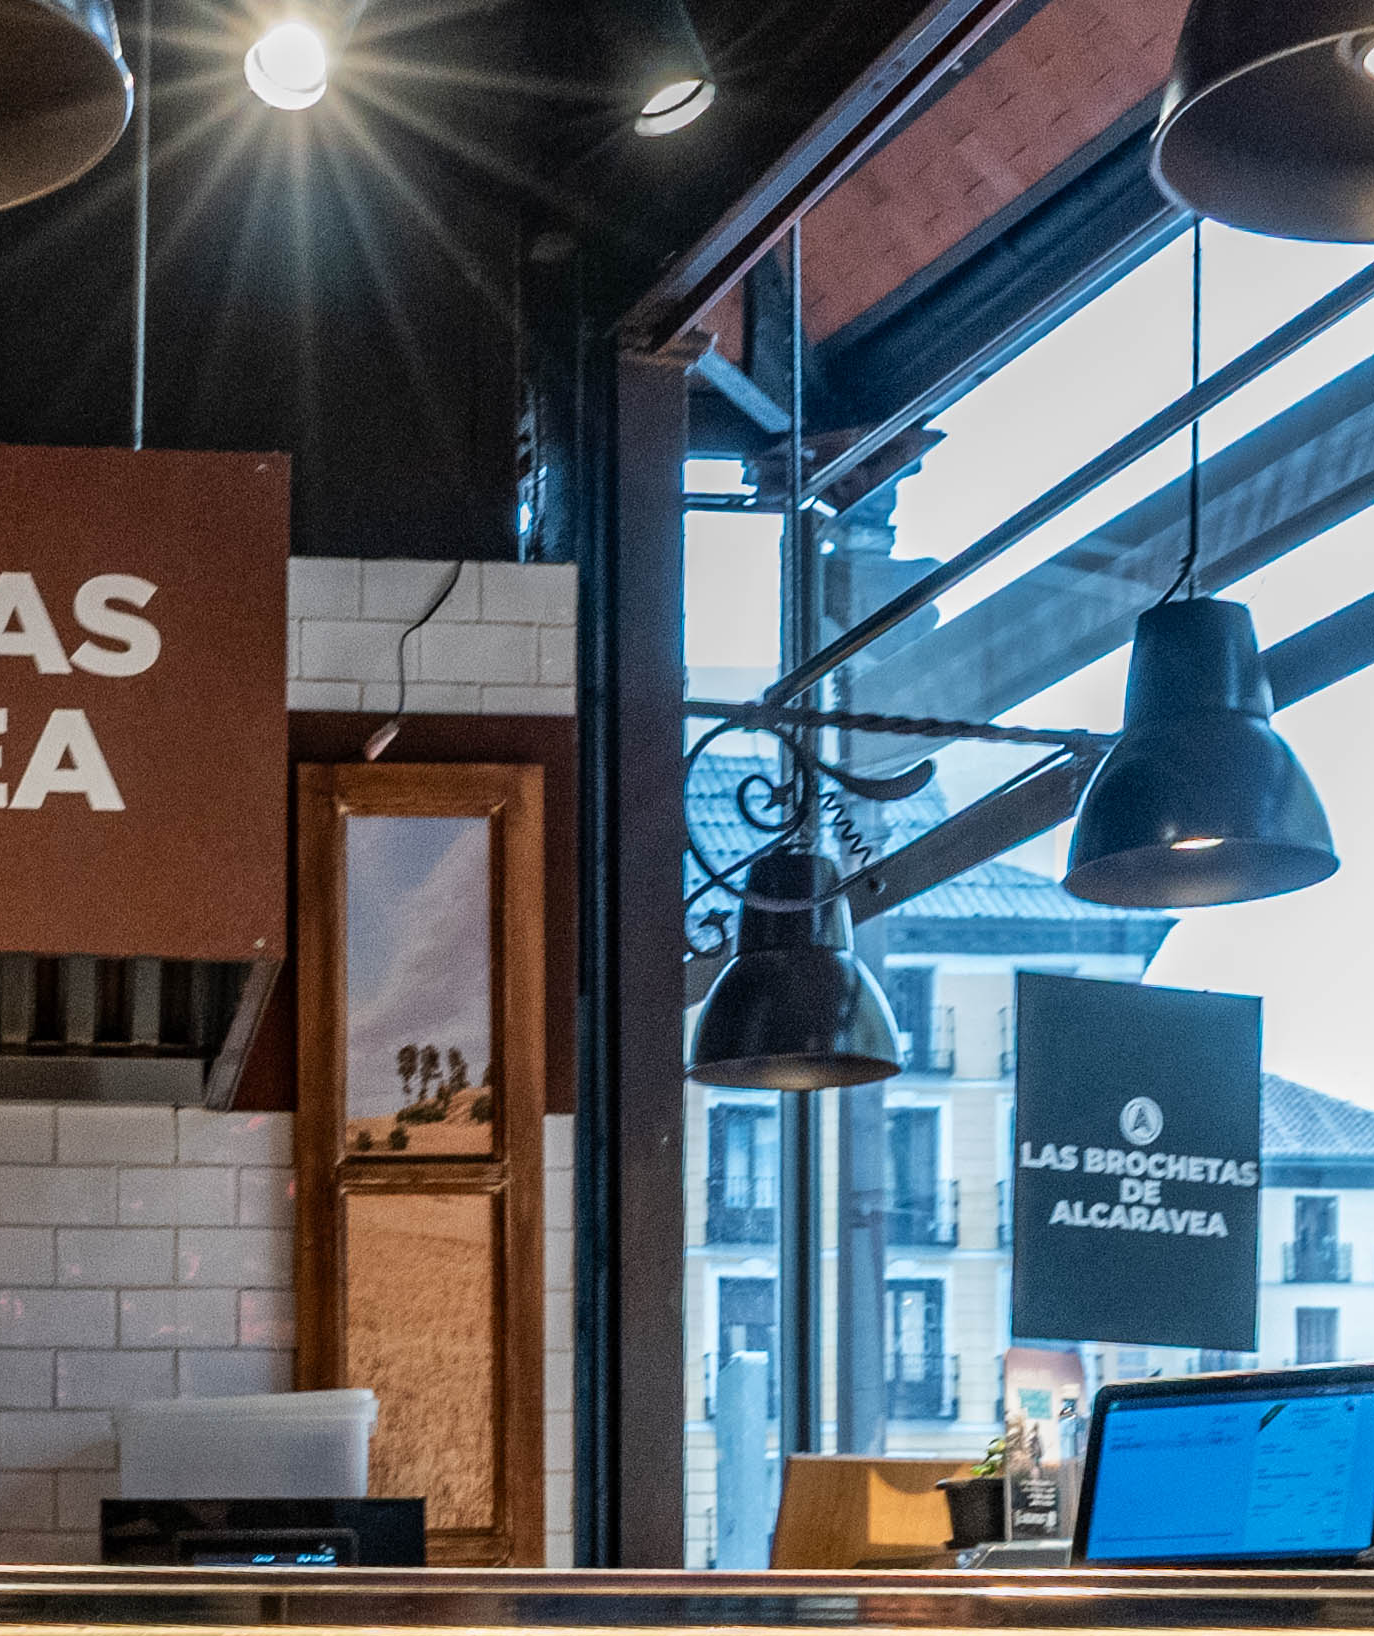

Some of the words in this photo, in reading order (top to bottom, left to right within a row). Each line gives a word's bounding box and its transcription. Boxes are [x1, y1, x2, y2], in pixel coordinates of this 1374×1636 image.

[1020, 1141, 1079, 1171] LAS
[1083, 1147, 1260, 1187] BROCHETAS
[1120, 1178, 1162, 1205] DE
[1048, 1200, 1229, 1238] ALCARAVEA
